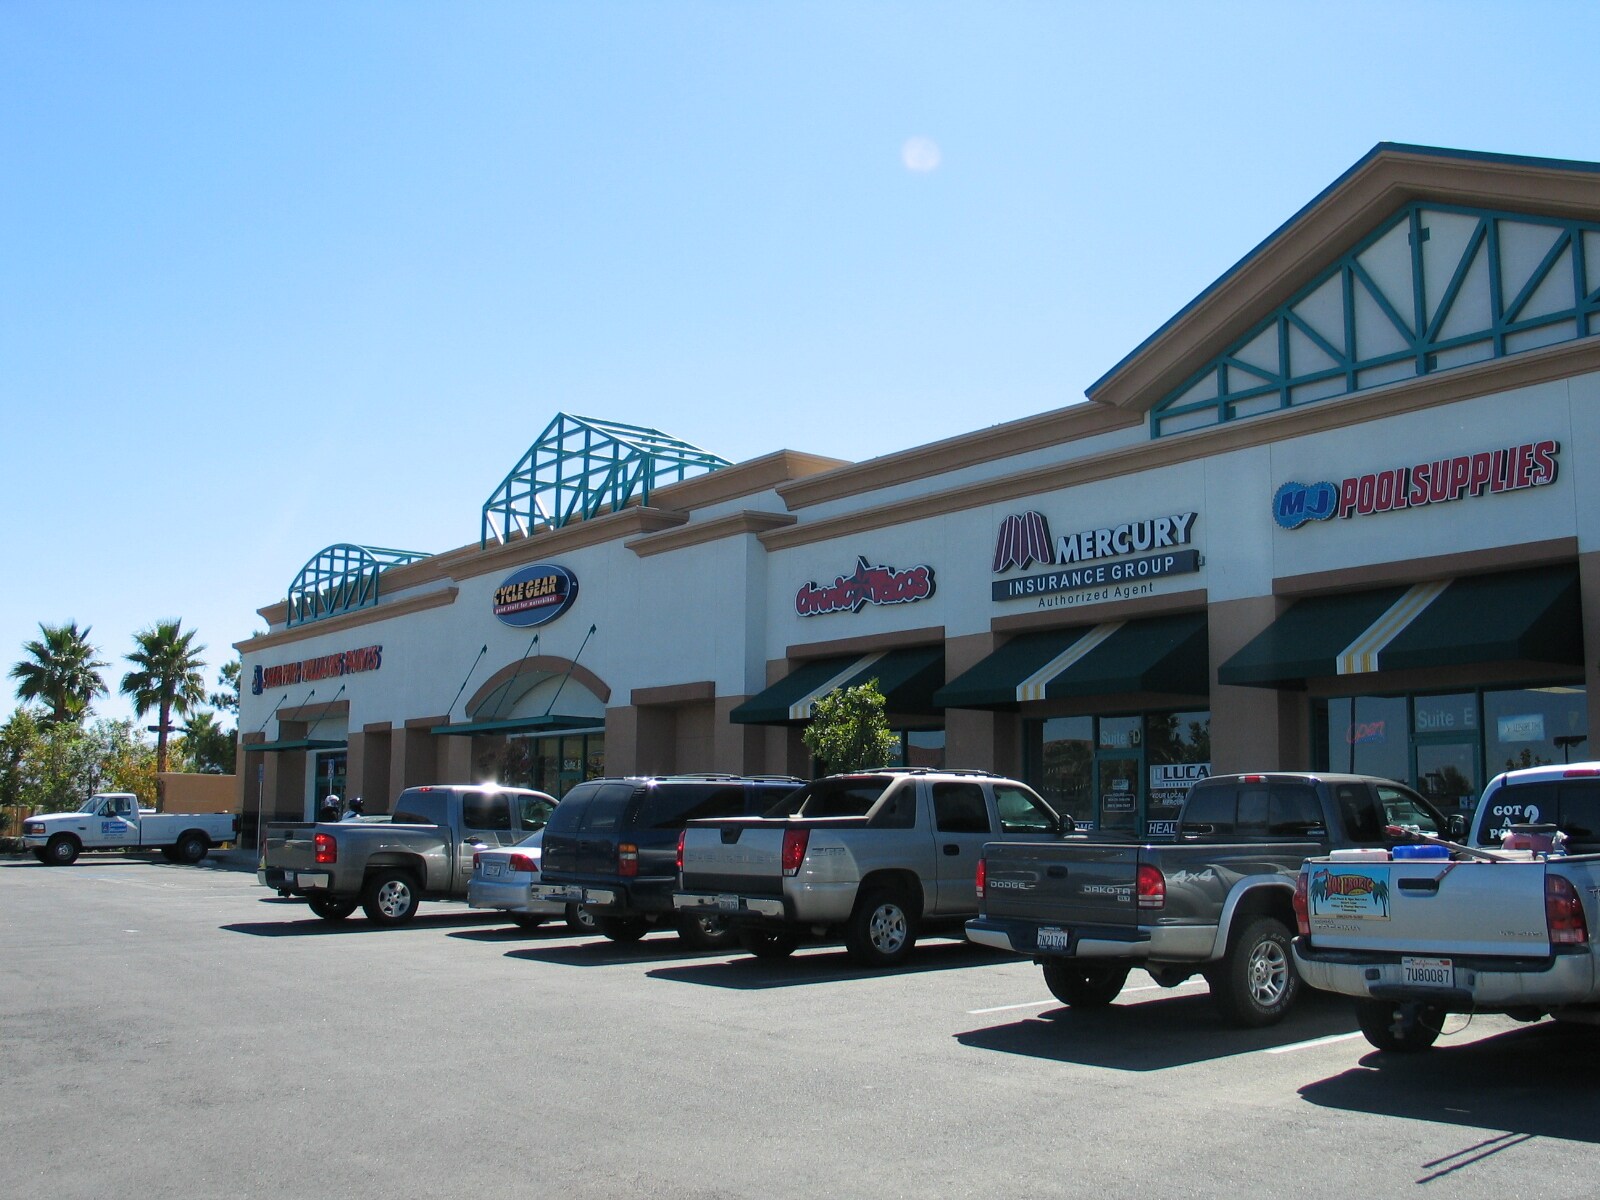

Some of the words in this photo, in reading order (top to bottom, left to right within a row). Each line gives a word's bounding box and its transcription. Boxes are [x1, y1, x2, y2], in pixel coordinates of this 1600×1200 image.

[1338, 467, 1410, 519] POOL
[1409, 440, 1561, 506] SUPPLIES
[1055, 512, 1198, 566] MERCURY
[1008, 567, 1106, 597] INSURANCE
[1111, 556, 1175, 580] GROUP
[493, 582, 525, 607] CYCLE
[525, 575, 558, 599] GEAR
[1038, 586, 1109, 609] Authorized
[1114, 581, 1154, 602] Agent
[1419, 710, 1454, 728] Suite
[1463, 707, 1474, 726] E
[1101, 729, 1127, 746] Suite
[1132, 729, 1141, 744] D
[1163, 765, 1211, 780] LUCA
[1493, 805, 1522, 816] GOT
[1148, 822, 1177, 835] HEAL
[1501, 816, 1512, 828] A
[990, 880, 1026, 890] DODGE
[1083, 885, 1131, 895] DAKOTA
[1405, 967, 1450, 983] 7U80087
